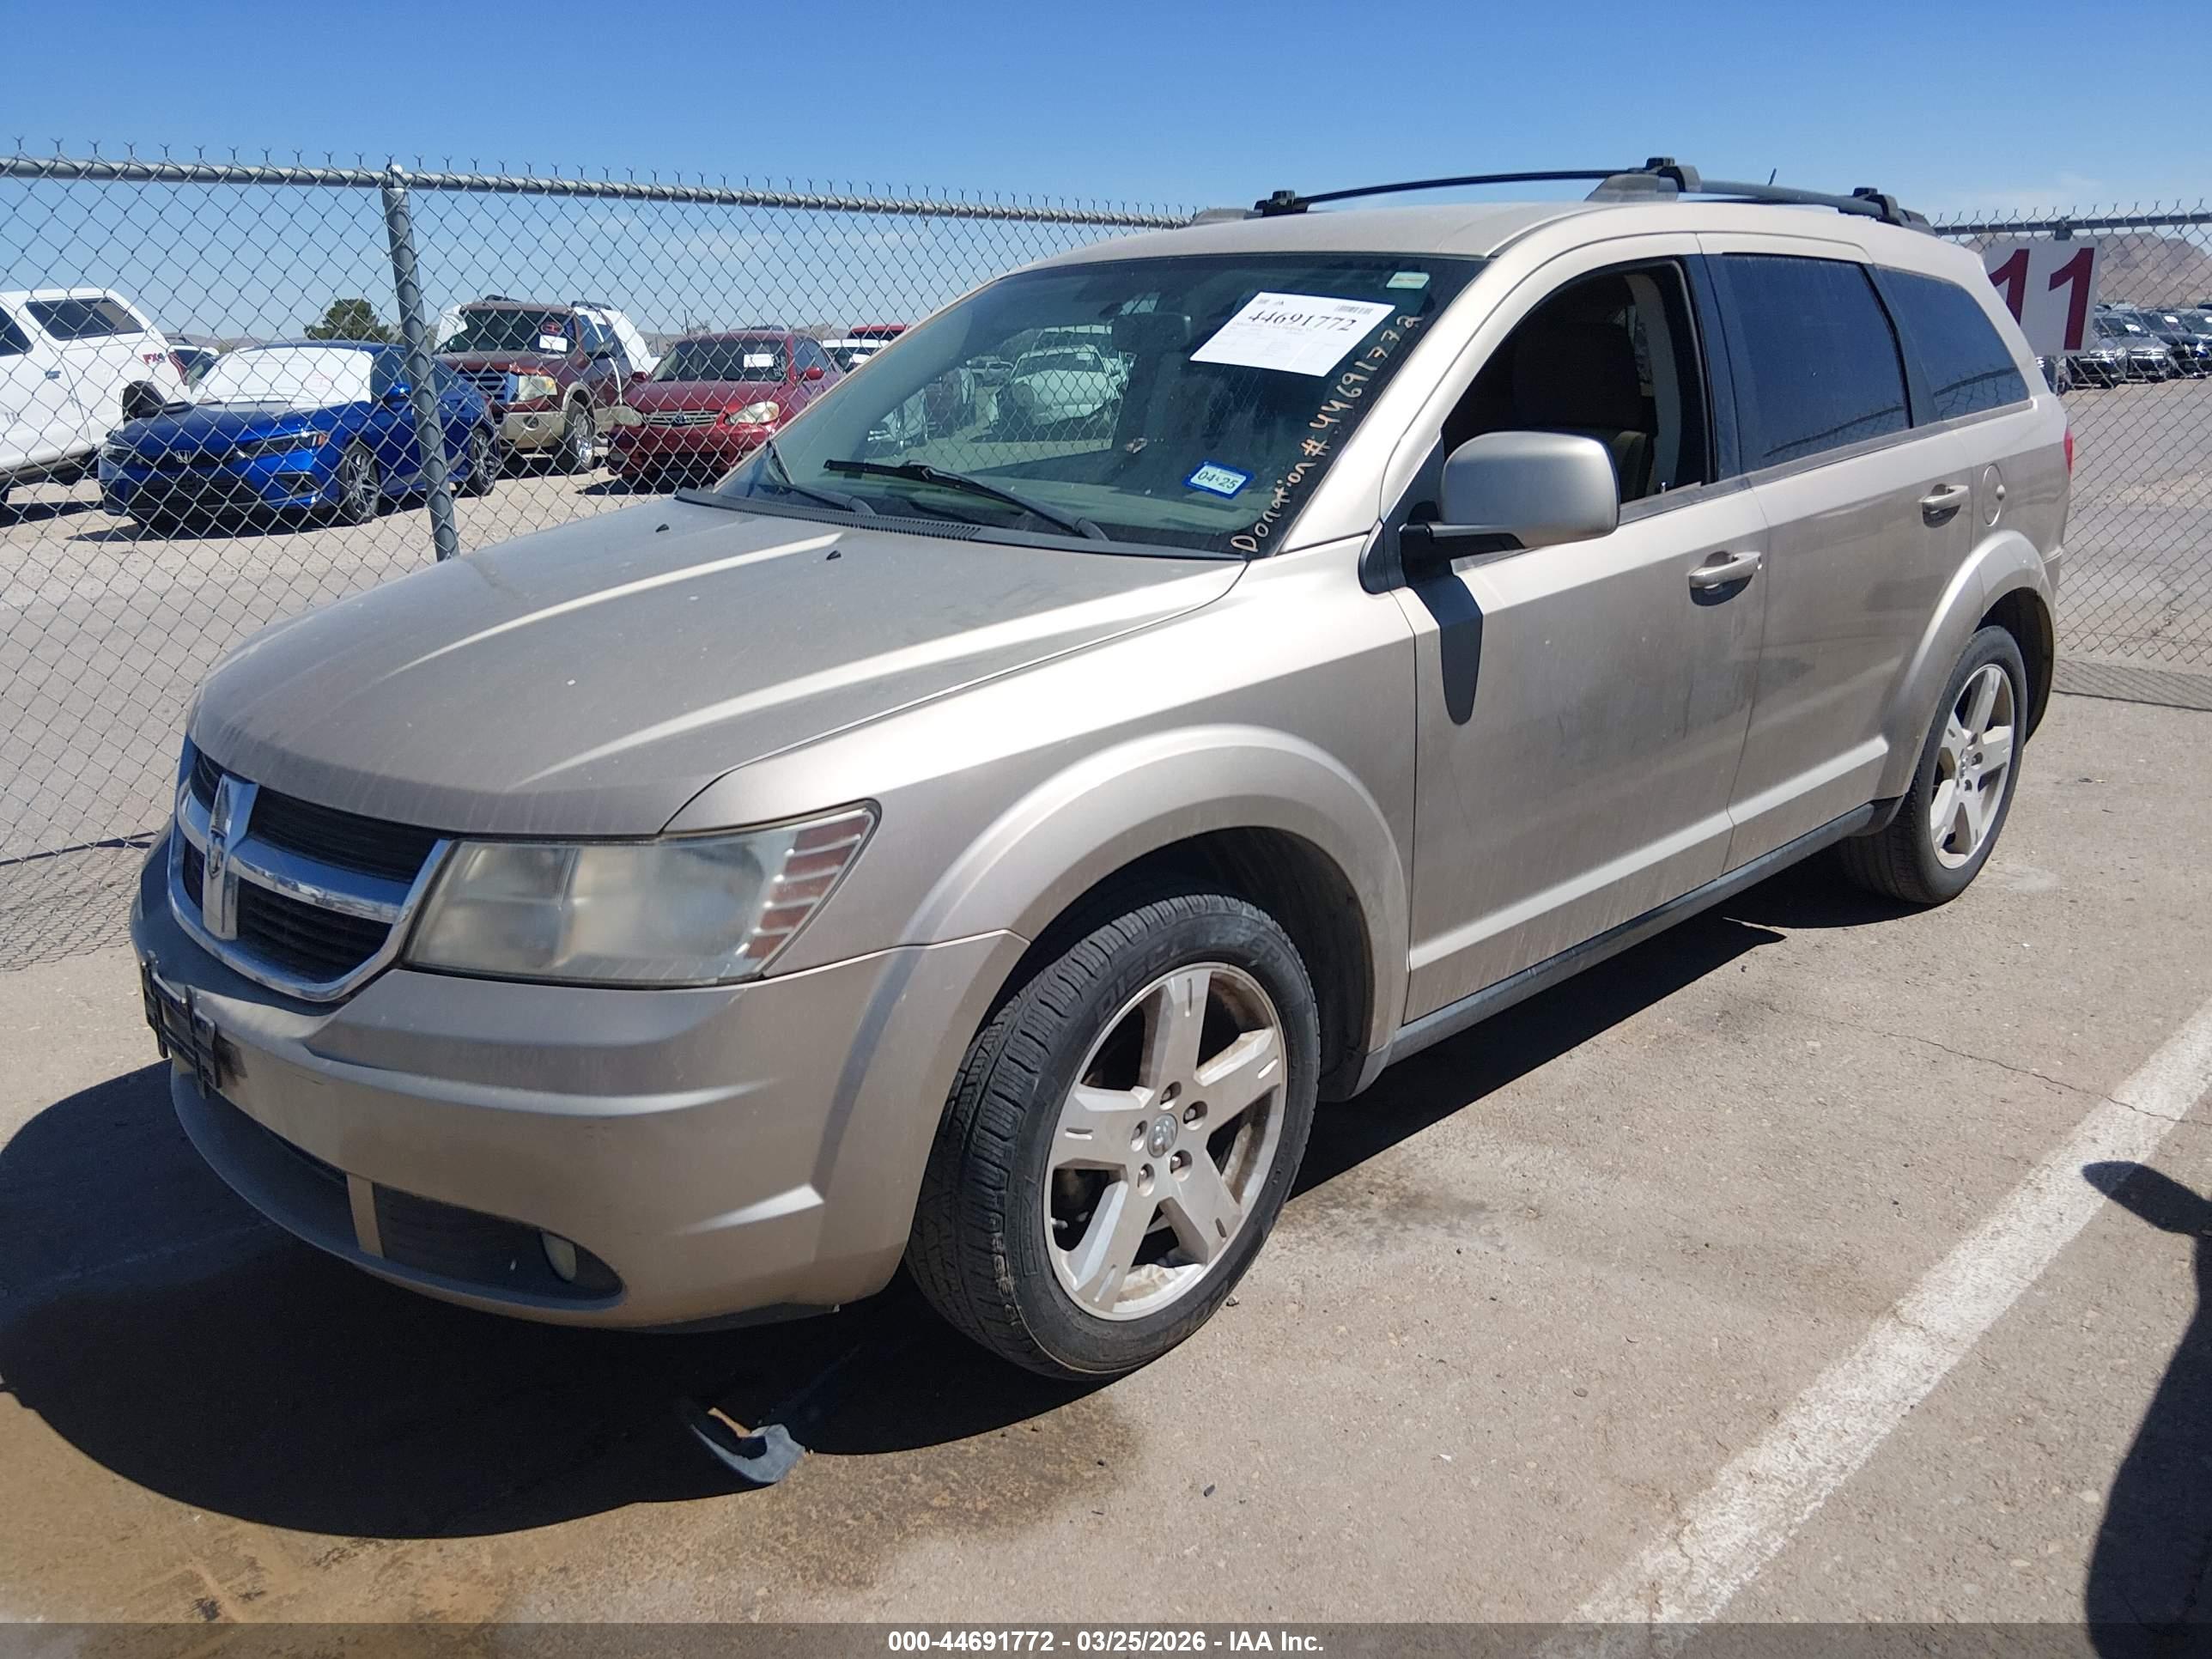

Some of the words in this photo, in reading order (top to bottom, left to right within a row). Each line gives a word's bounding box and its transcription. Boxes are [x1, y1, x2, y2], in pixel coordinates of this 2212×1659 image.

[1249, 310, 1357, 331] 44691772
[1989, 247, 2095, 350] 11
[1231, 462, 1316, 552] Donation
